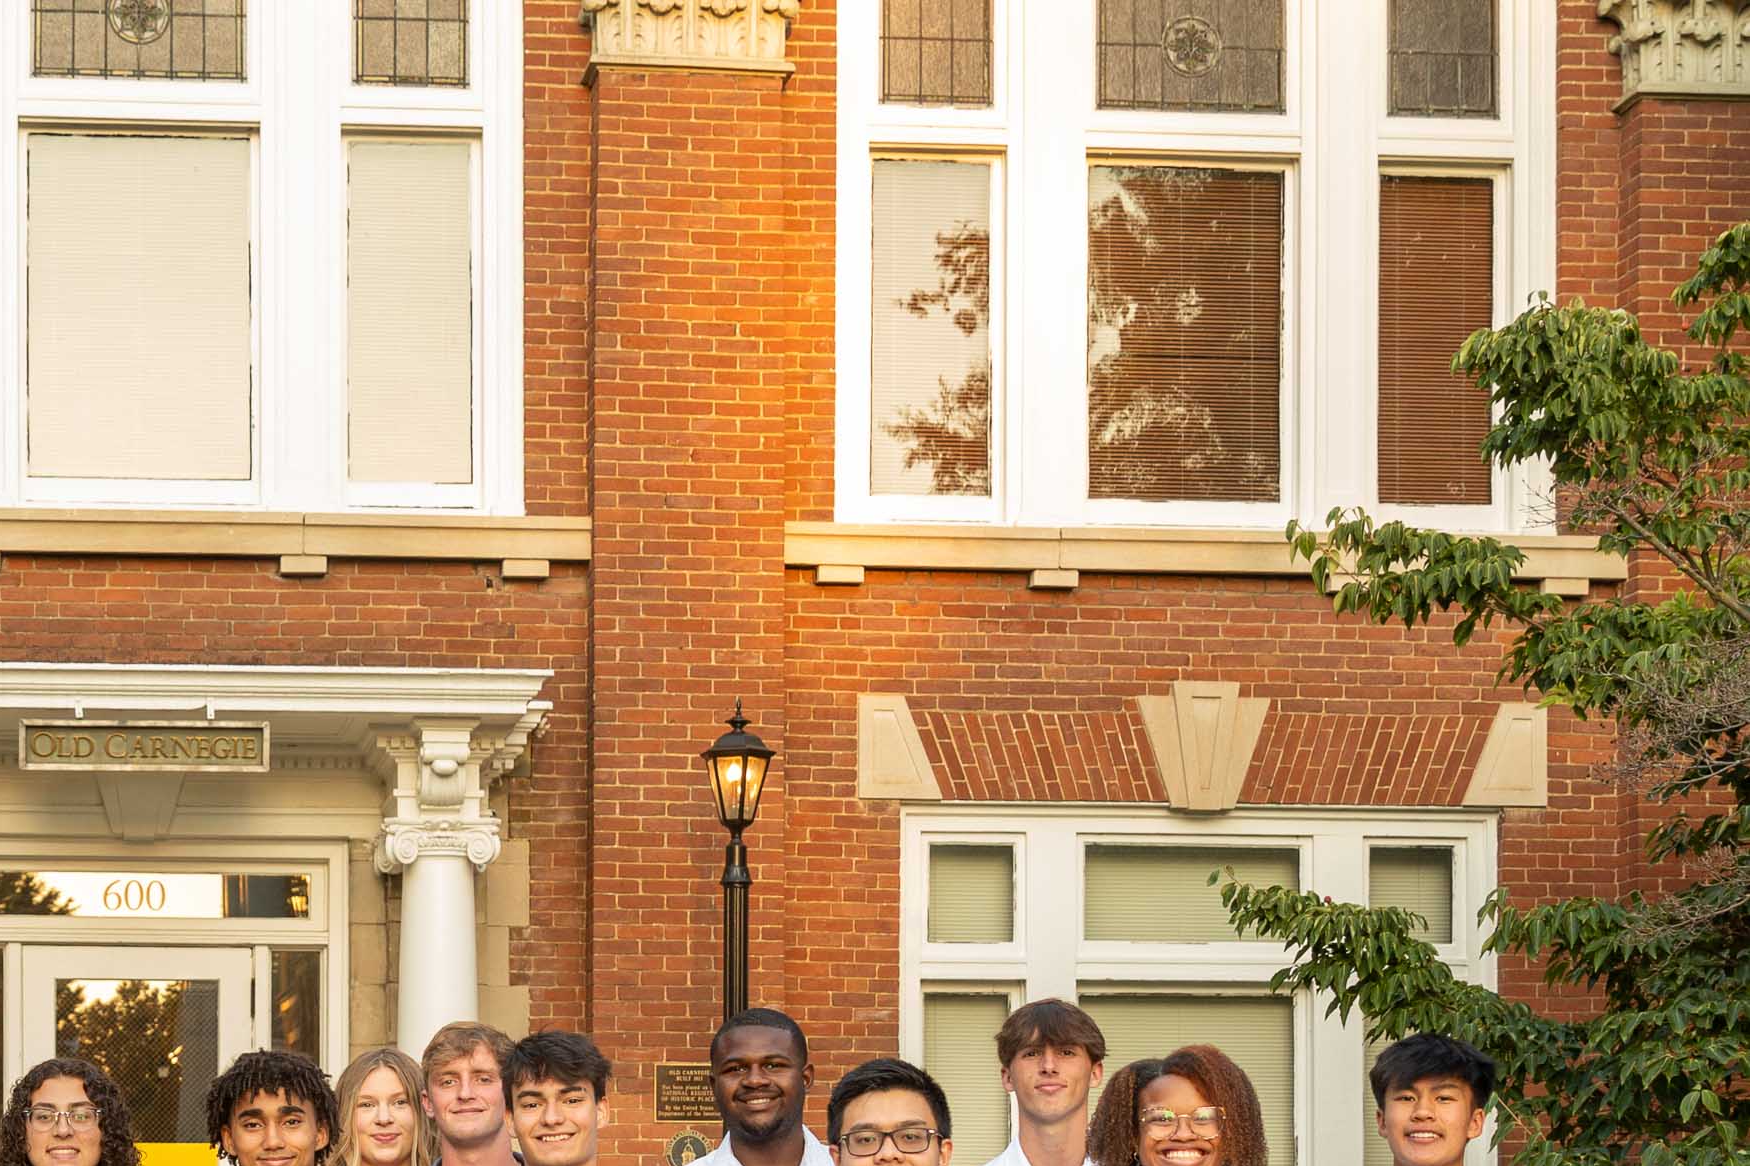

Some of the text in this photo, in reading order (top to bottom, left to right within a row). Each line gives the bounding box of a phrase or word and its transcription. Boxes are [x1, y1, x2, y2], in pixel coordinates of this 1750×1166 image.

[30, 731, 258, 760] OLD CARNEGIE
[103, 879, 166, 911] 600
